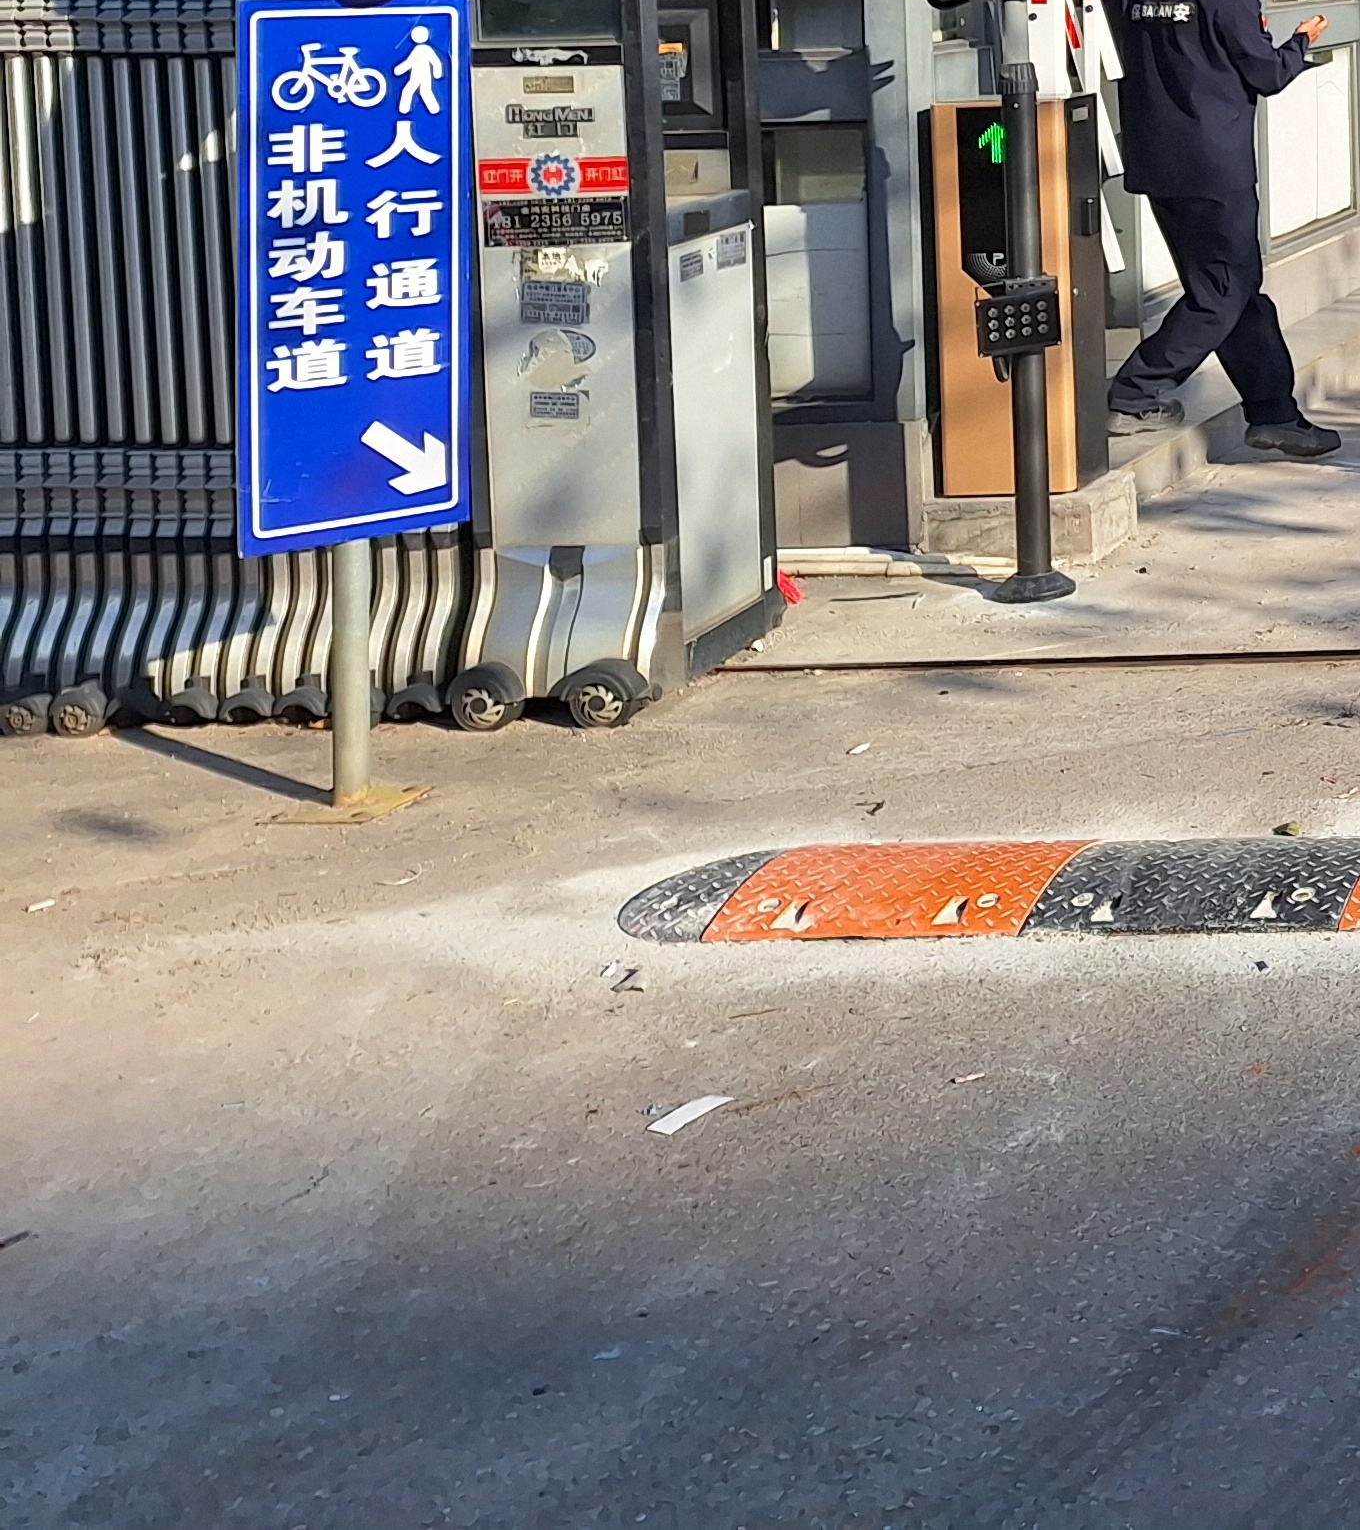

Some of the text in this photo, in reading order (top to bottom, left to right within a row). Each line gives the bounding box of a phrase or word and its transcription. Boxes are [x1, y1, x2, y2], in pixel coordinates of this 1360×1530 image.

[1172, 3, 1191, 22] 安
[266, 122, 350, 393] 非机动车道
[365, 119, 444, 382] 人行通道
[530, 213, 572, 228] 2356
[580, 211, 622, 226] 5975
